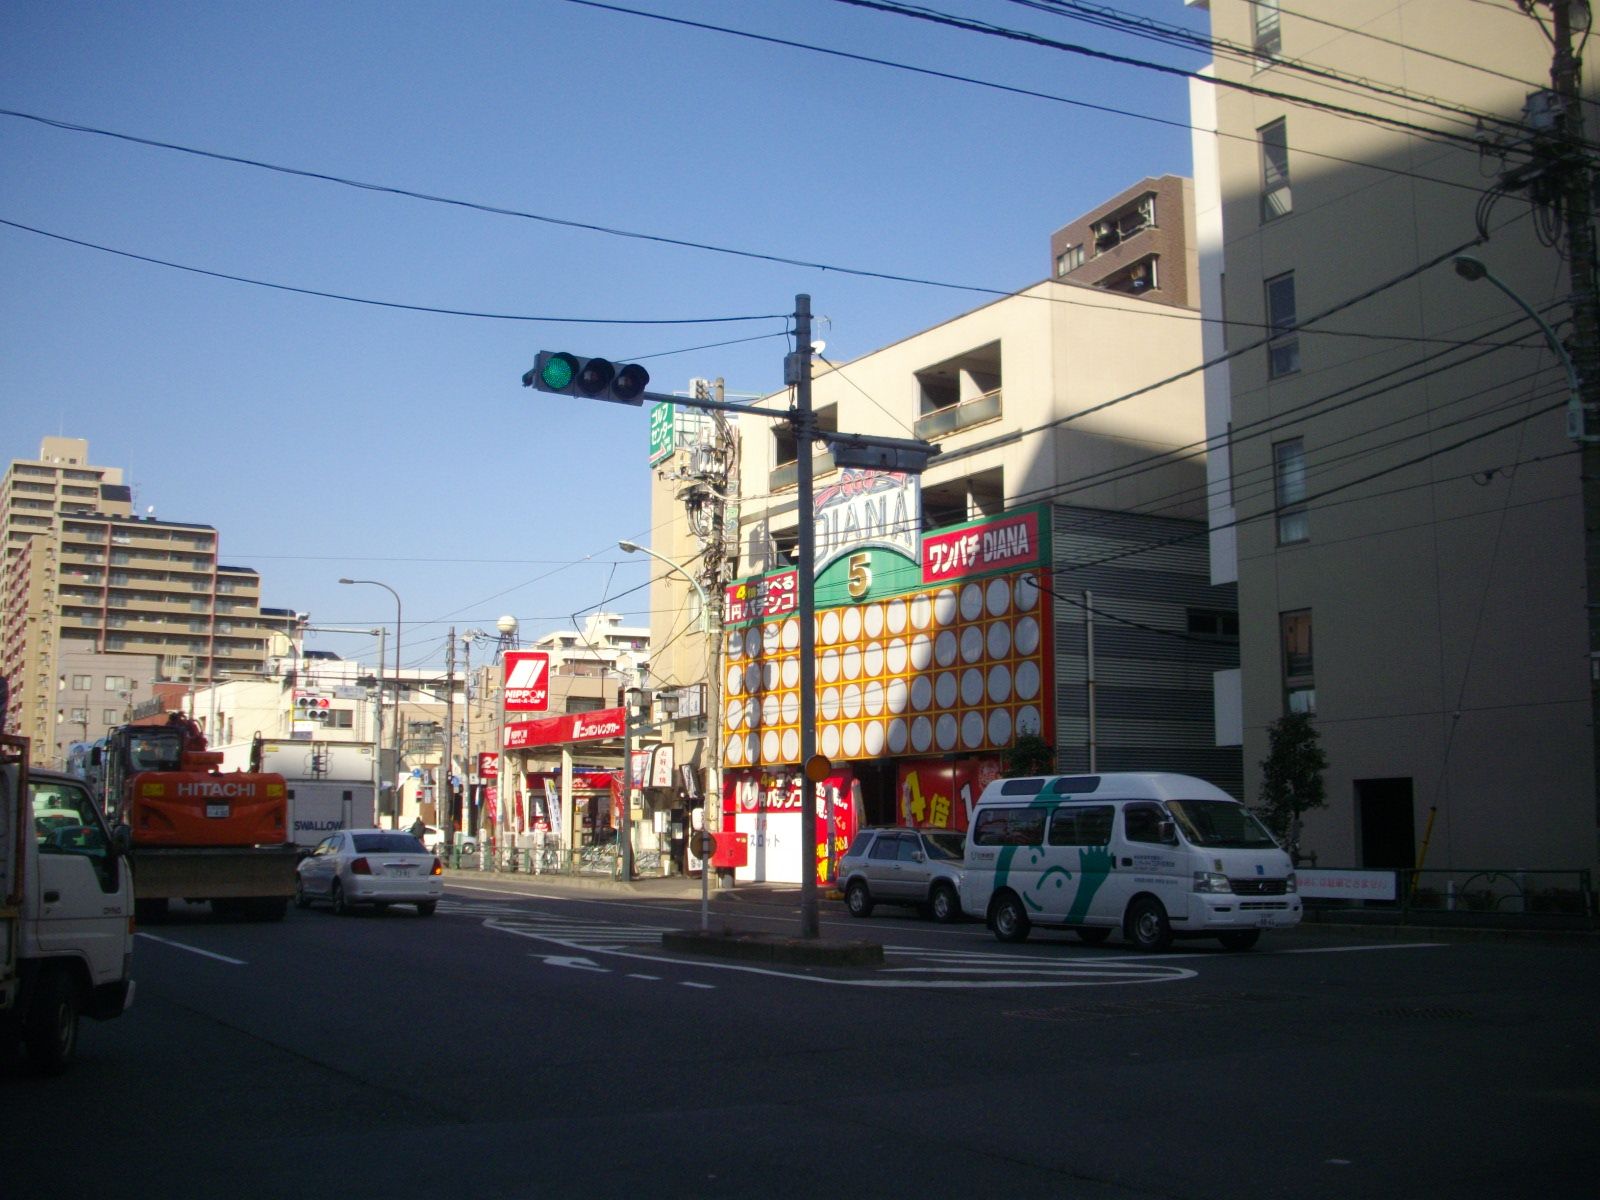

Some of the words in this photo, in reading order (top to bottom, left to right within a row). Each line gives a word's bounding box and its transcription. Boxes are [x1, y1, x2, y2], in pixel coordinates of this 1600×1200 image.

[929, 532, 981, 575] ワンパチ
[982, 522, 1029, 563] DIANA
[847, 553, 873, 597] 5
[505, 689, 545, 699] NIPPON
[177, 783, 256, 797] HITACHI
[294, 821, 344, 830] SWALLOW
